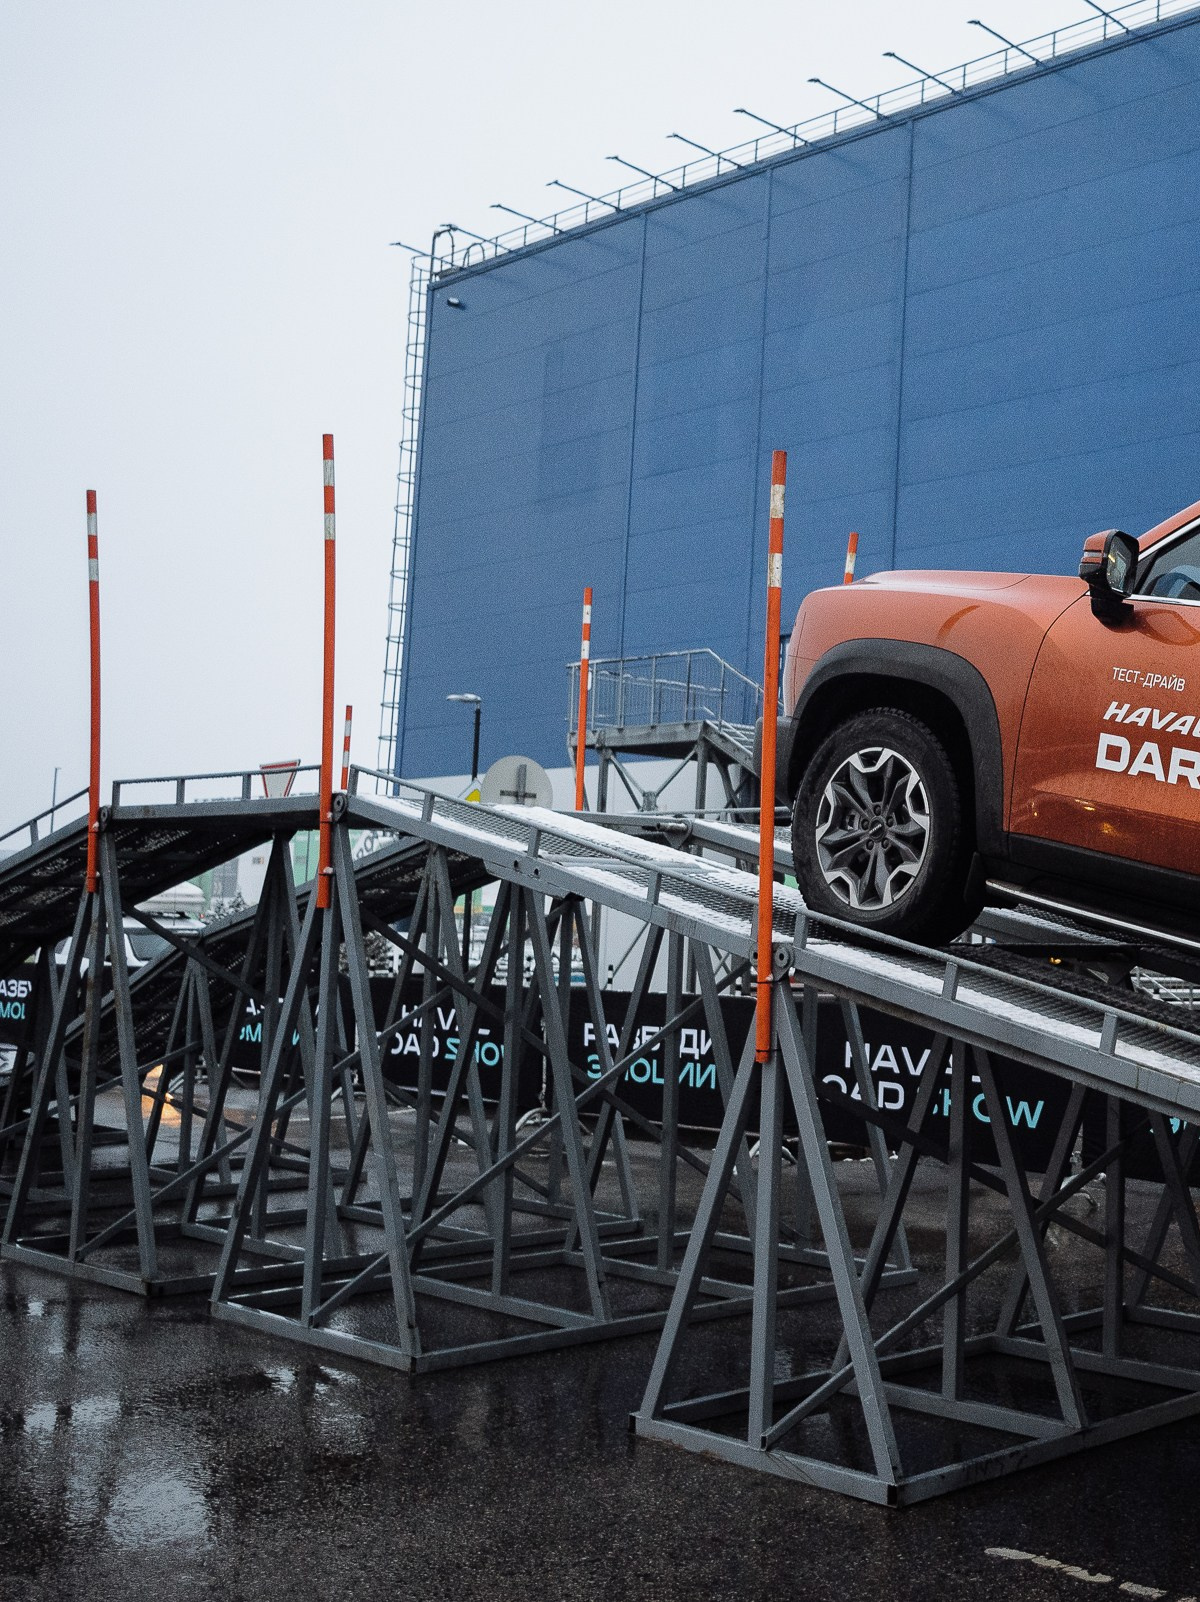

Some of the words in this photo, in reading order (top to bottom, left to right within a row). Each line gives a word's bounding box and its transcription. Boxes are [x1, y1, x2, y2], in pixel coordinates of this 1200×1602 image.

[1112, 666, 1186, 692] ТЕСТ-ДРАЙВ
[587, 1054, 717, 1090] ЭОЦИИ
[844, 1041, 981, 1083] HAV
